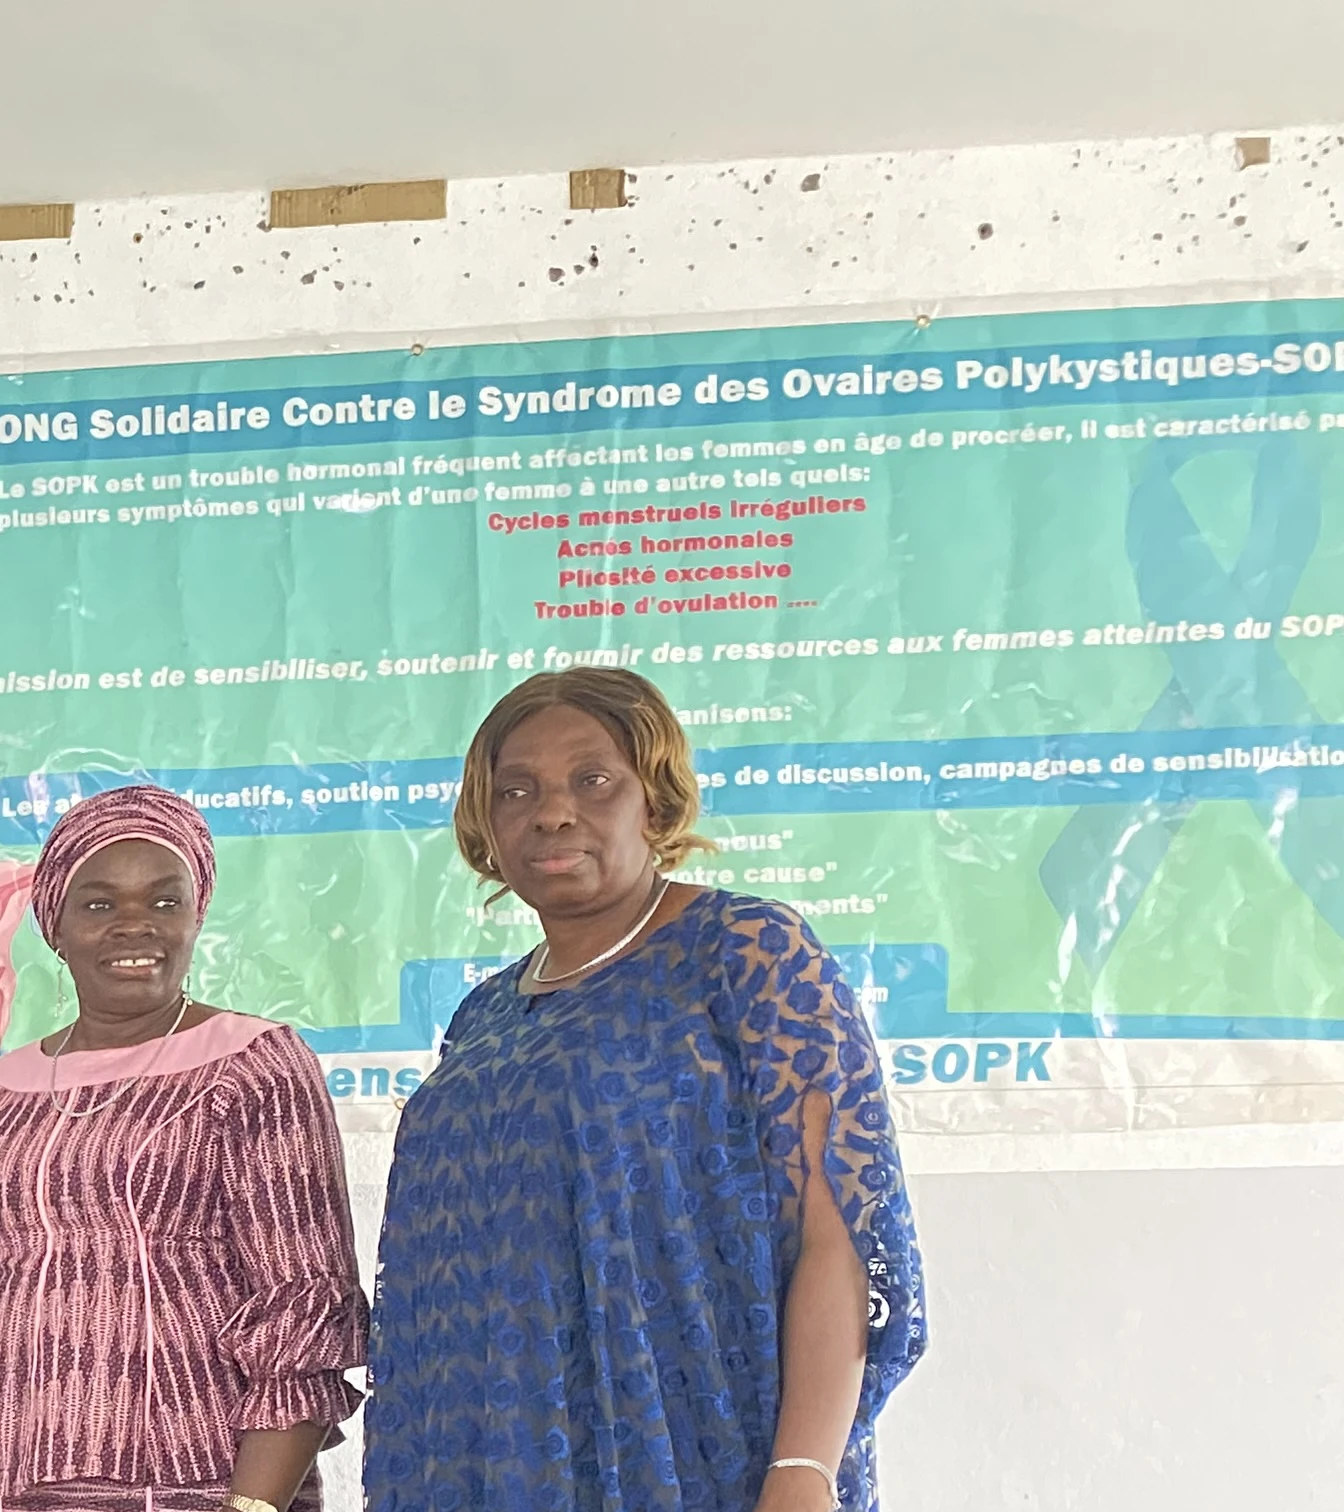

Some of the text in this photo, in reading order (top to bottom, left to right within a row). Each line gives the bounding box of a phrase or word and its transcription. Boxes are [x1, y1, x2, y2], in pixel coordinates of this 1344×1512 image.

[90, 402, 270, 439] Solidaire
[282, 395, 416, 427] Contre
[429, 390, 466, 420] le
[478, 382, 682, 422] Syndrome
[694, 374, 770, 402] des
[783, 365, 944, 398] Ovaires
[32, 475, 99, 497] SOPK
[105, 473, 146, 494] est
[152, 473, 182, 490] un
[190, 464, 280, 488] trouble
[287, 456, 406, 482] hormonal
[412, 451, 521, 477] fréquent
[529, 444, 649, 469] affectant
[655, 443, 694, 462] les
[702, 437, 806, 460] femmes
[814, 436, 846, 454] en
[854, 432, 902, 455] âge
[909, 429, 944, 449] de
[952, 422, 1073, 451] procréer,
[1105, 417, 1146, 439] est
[1153, 411, 1311, 438] caractérisé
[117, 498, 259, 526] symptômes
[266, 492, 305, 517] qui
[408, 485, 479, 506] d'une
[484, 481, 572, 501] femme
[579, 476, 596, 497] à
[603, 477, 649, 495] une
[655, 470, 726, 493] autre
[733, 468, 781, 488] tels
[790, 463, 871, 488] quels:
[487, 511, 570, 534] Cycles
[579, 502, 722, 527] menstruels
[641, 530, 794, 554] hormonales
[664, 561, 792, 583] excessive
[534, 599, 626, 620] Trouble
[634, 592, 779, 615] d'ovulation
[98, 667, 143, 690] est
[150, 665, 186, 688] de
[194, 657, 368, 685] sensibiliser,
[376, 647, 499, 676] soutenir
[507, 648, 535, 669] et
[543, 643, 643, 668] fournir
[651, 642, 703, 664] des
[713, 635, 878, 661] ressources
[887, 632, 944, 655] aux
[952, 628, 1074, 651] femmes
[1082, 620, 1225, 646] atteintes
[1234, 617, 1272, 640] du
[1280, 614, 1344, 638] SOP
[677, 704, 792, 725] anisons:
[301, 781, 400, 804] soutien
[735, 766, 769, 786] de
[778, 762, 931, 784] discussion,
[939, 757, 1102, 782] campagnes
[1110, 753, 1145, 773] de
[744, 862, 837, 883] cause"
[891, 1042, 1053, 1084] SOPK
